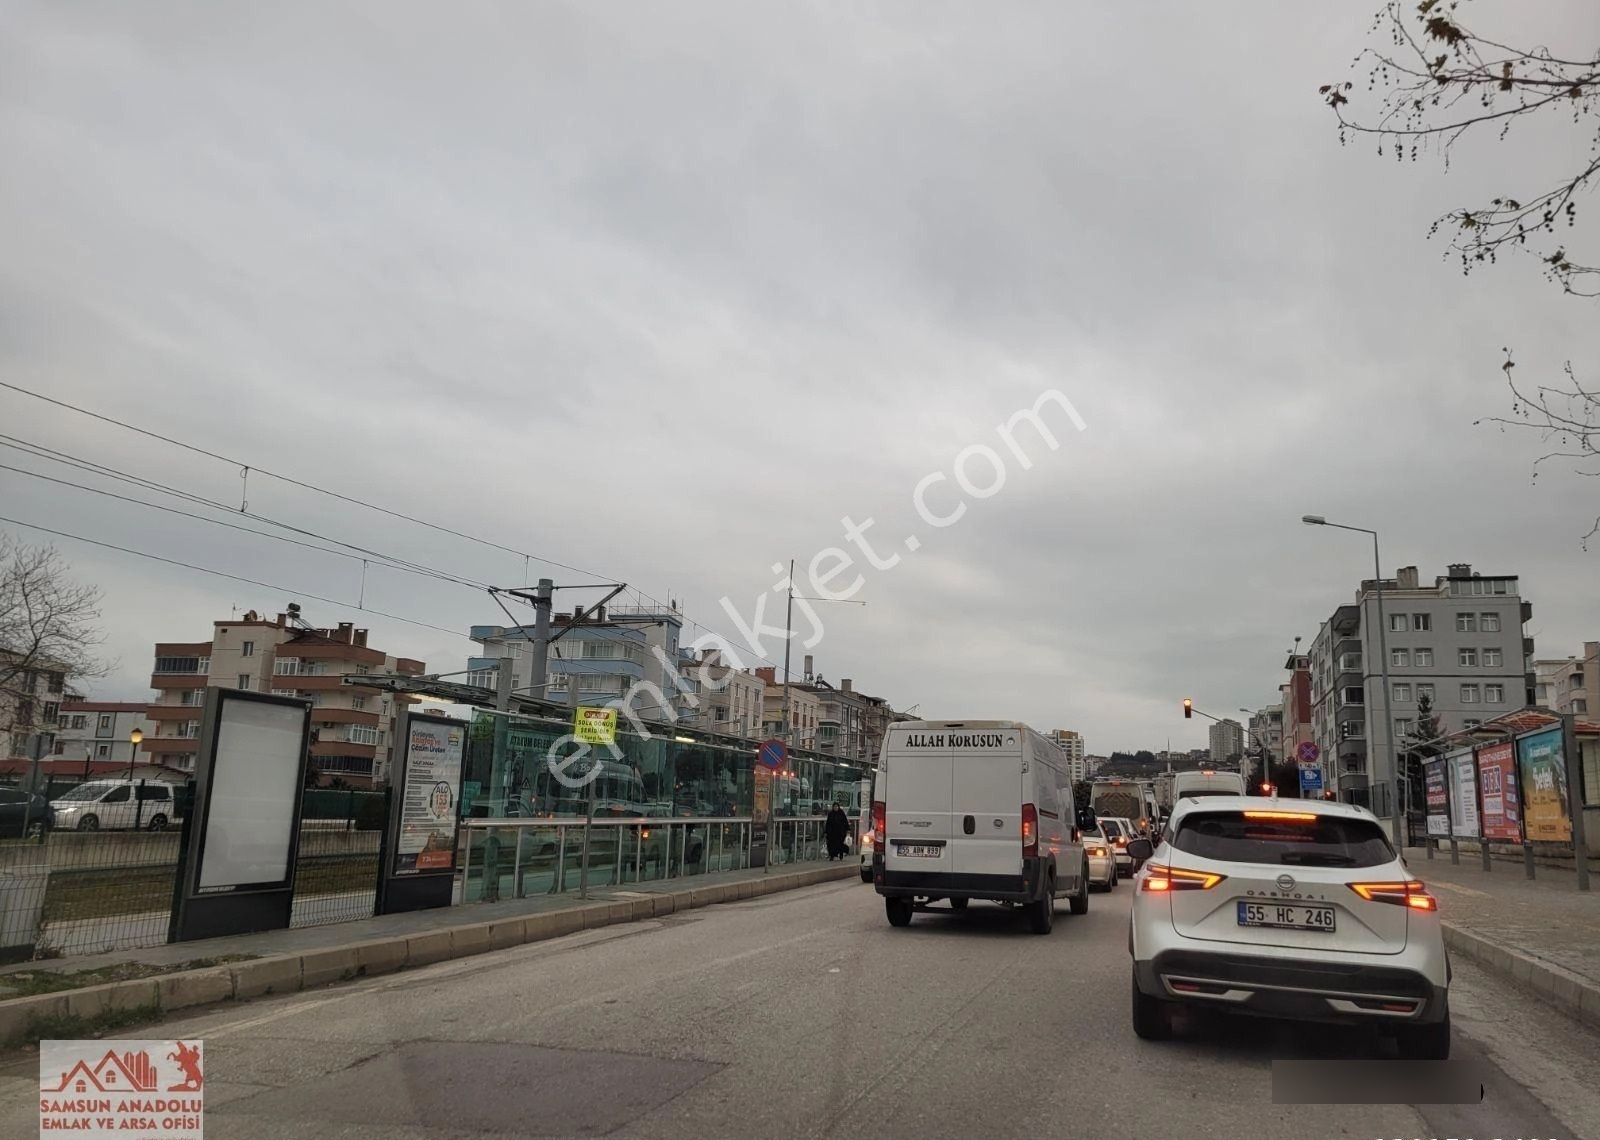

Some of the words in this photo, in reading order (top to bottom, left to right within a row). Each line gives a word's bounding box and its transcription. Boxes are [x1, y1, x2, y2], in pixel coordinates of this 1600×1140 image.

[906, 734, 944, 747] ALLAH
[948, 734, 1003, 748] KORUSUN
[1247, 905, 1265, 921] 55
[1277, 907, 1294, 923] HC
[1305, 909, 1332, 926] 246
